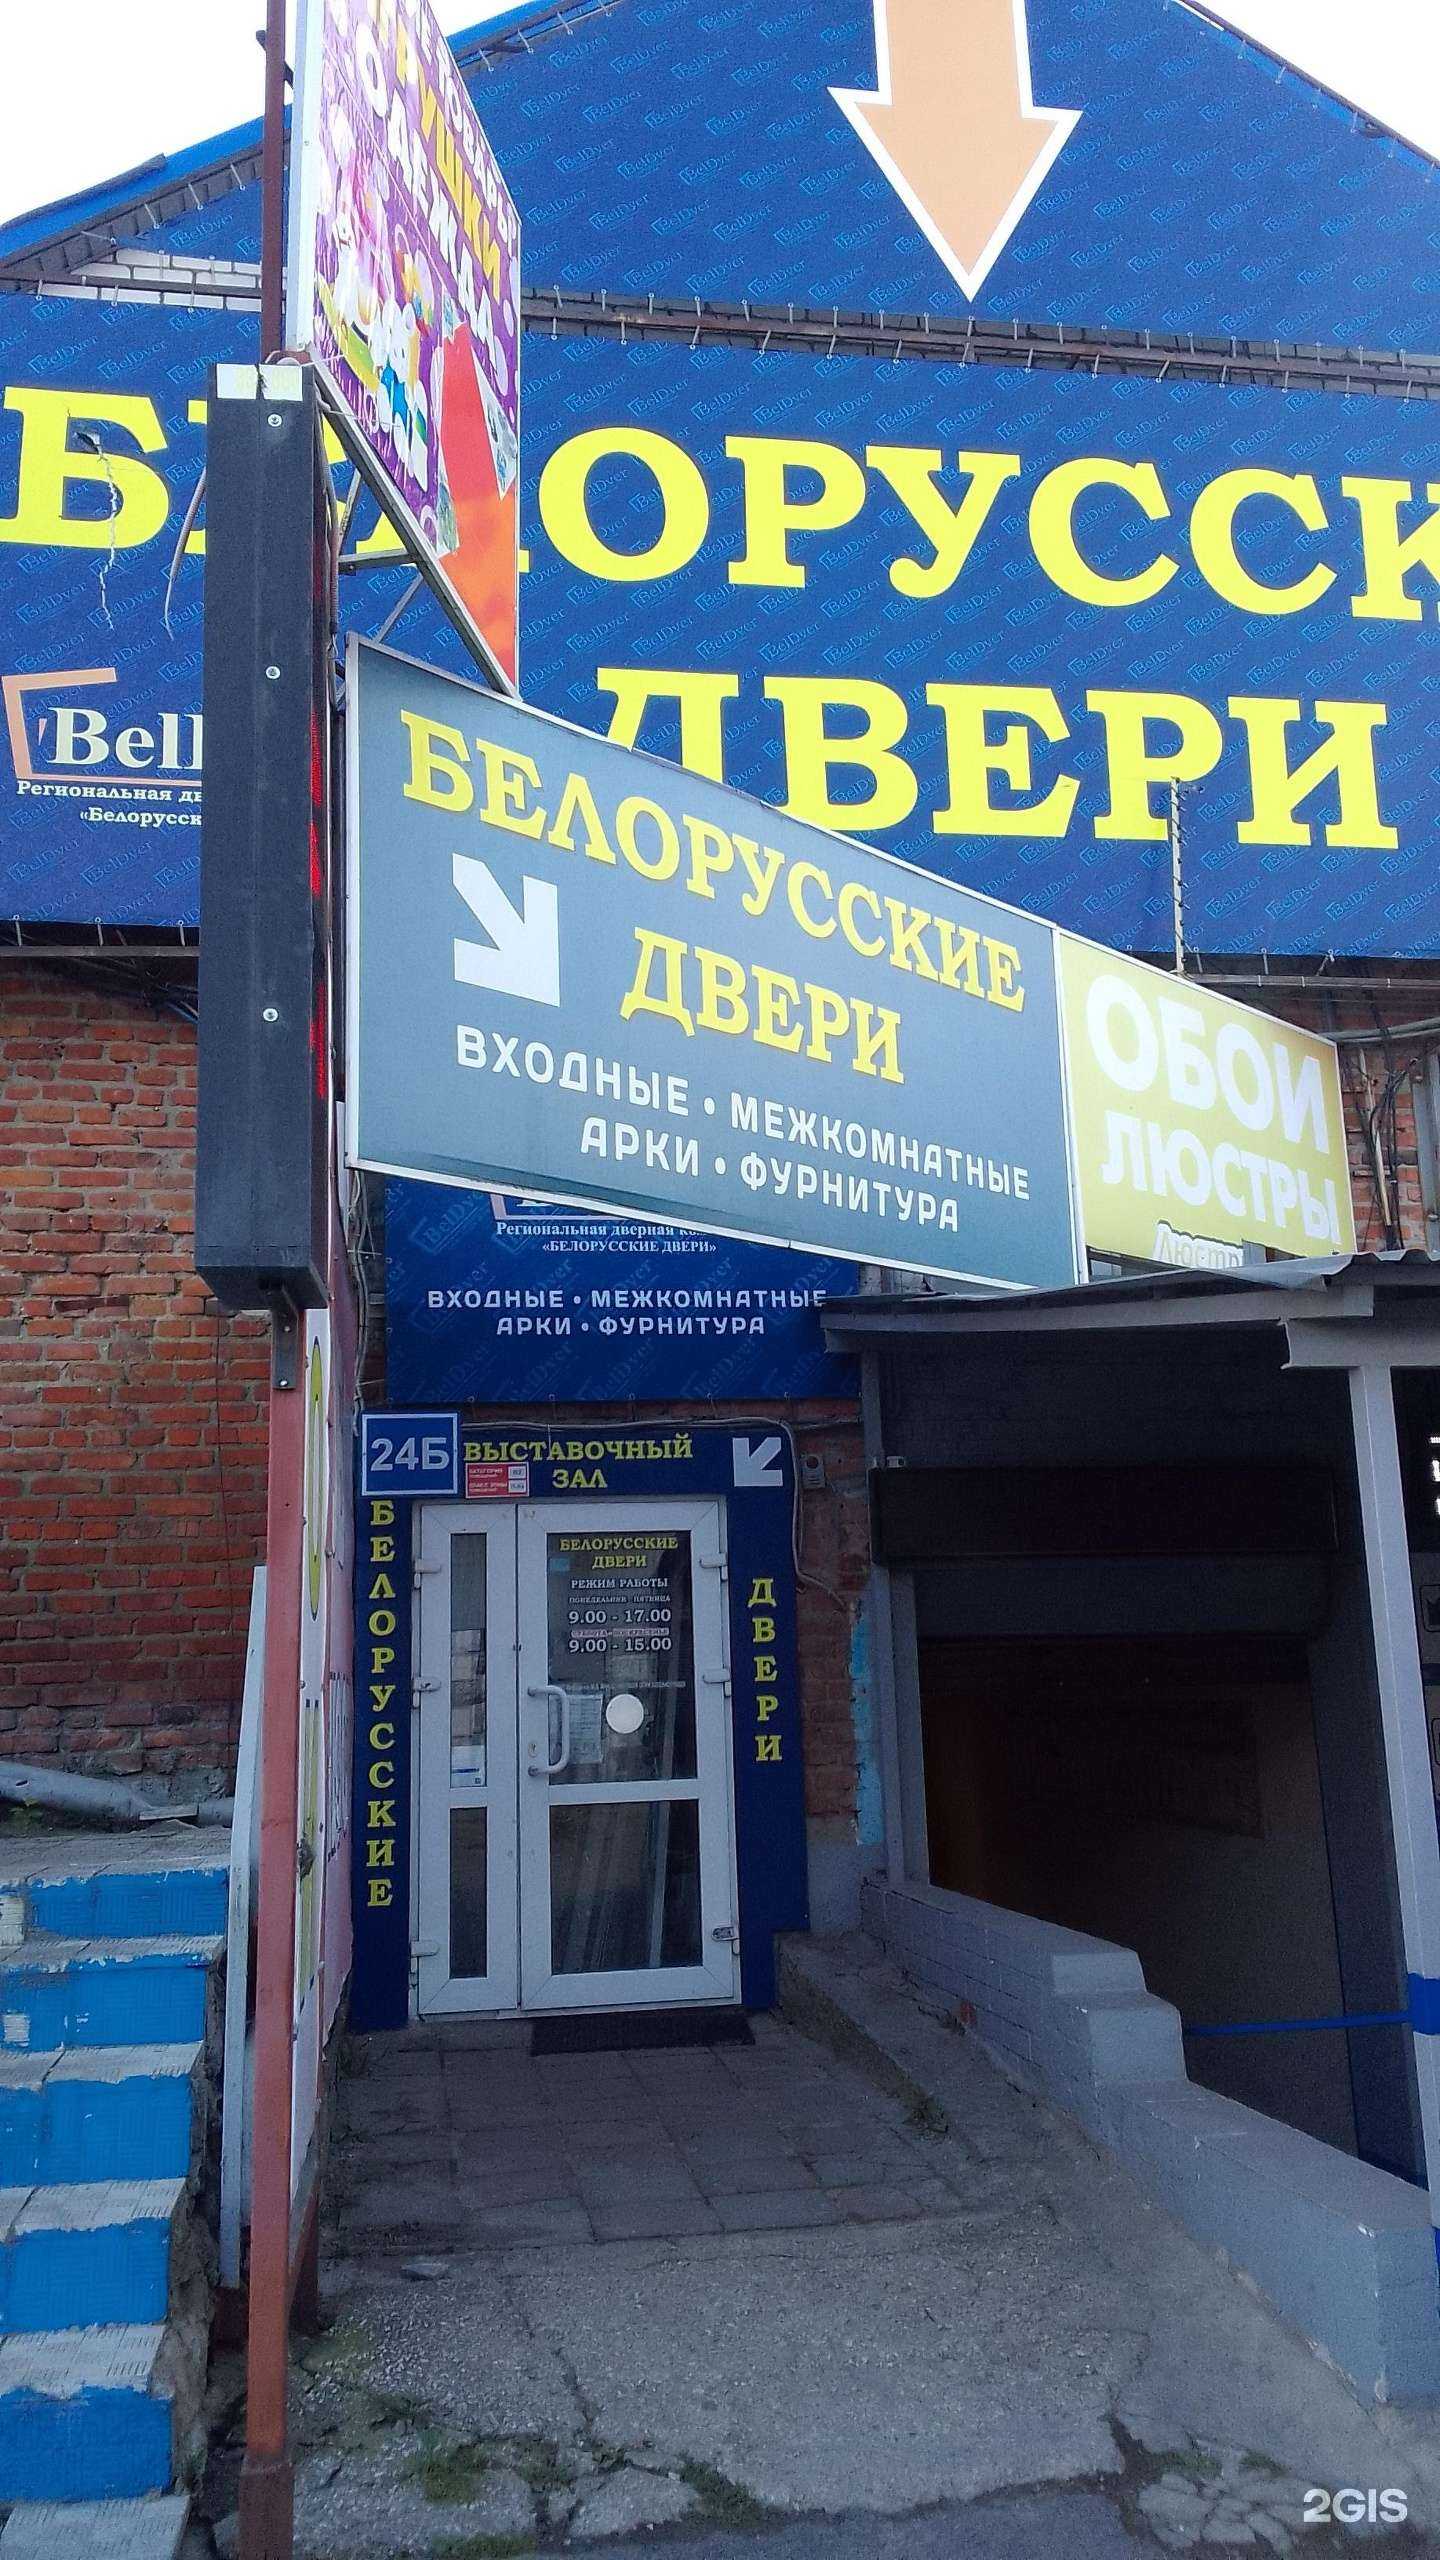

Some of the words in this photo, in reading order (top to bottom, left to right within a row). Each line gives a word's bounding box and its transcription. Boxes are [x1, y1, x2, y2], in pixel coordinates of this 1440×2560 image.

[597, 667, 1399, 851] ДВЕРИ
[16, 780, 172, 802] Региональная
[401, 709, 1026, 1012] БЕЛОРУССКИЕ
[620, 925, 905, 1085] ДВЕРИ
[1085, 974, 1329, 1154] ОБОИ
[457, 1024, 690, 1116] ВХОДНЫЕ
[731, 1092, 1030, 1200] МЕЖКОМНАТНЫЕ
[580, 1117, 701, 1177] АРКИ
[741, 1152, 960, 1232] ФУРНИТУРА
[1101, 1111, 1342, 1245] ЛЮСТРЫ
[496, 1221, 607, 1236] Региональная
[542, 1240, 659, 1253] «БЕЛОРУССКИЕ
[661, 1240, 717, 1254] ДВЕРИ»
[427, 1289, 564, 1309] ВХОДНЫЕ
[591, 1289, 827, 1308] МЕЖКОМНАТНЫЕ
[496, 1317, 571, 1337] АРКИ
[598, 1316, 765, 1336] ФУРНИТУРА
[370, 1437, 449, 1471] 24Б
[464, 1433, 694, 1463] ВЫСТАВОЧНЫЙ
[552, 1469, 608, 1489] ЗАЛ
[559, 1536, 679, 1552] БЕЛОРУССКИЕ
[591, 1555, 648, 1570] ДВЕРИ
[571, 1579, 616, 1589] РЕЖИМ
[619, 1578, 669, 1588] РАБОТЫ
[568, 1610, 607, 1624] 9.00
[625, 1609, 672, 1623] 17.00
[569, 1639, 607, 1654] 9.00
[626, 1638, 672, 1652] 15.00
[747, 1577, 783, 1763] ДВЕРИ
[366, 1500, 396, 1907] БЕЛОРУССКИЕ
